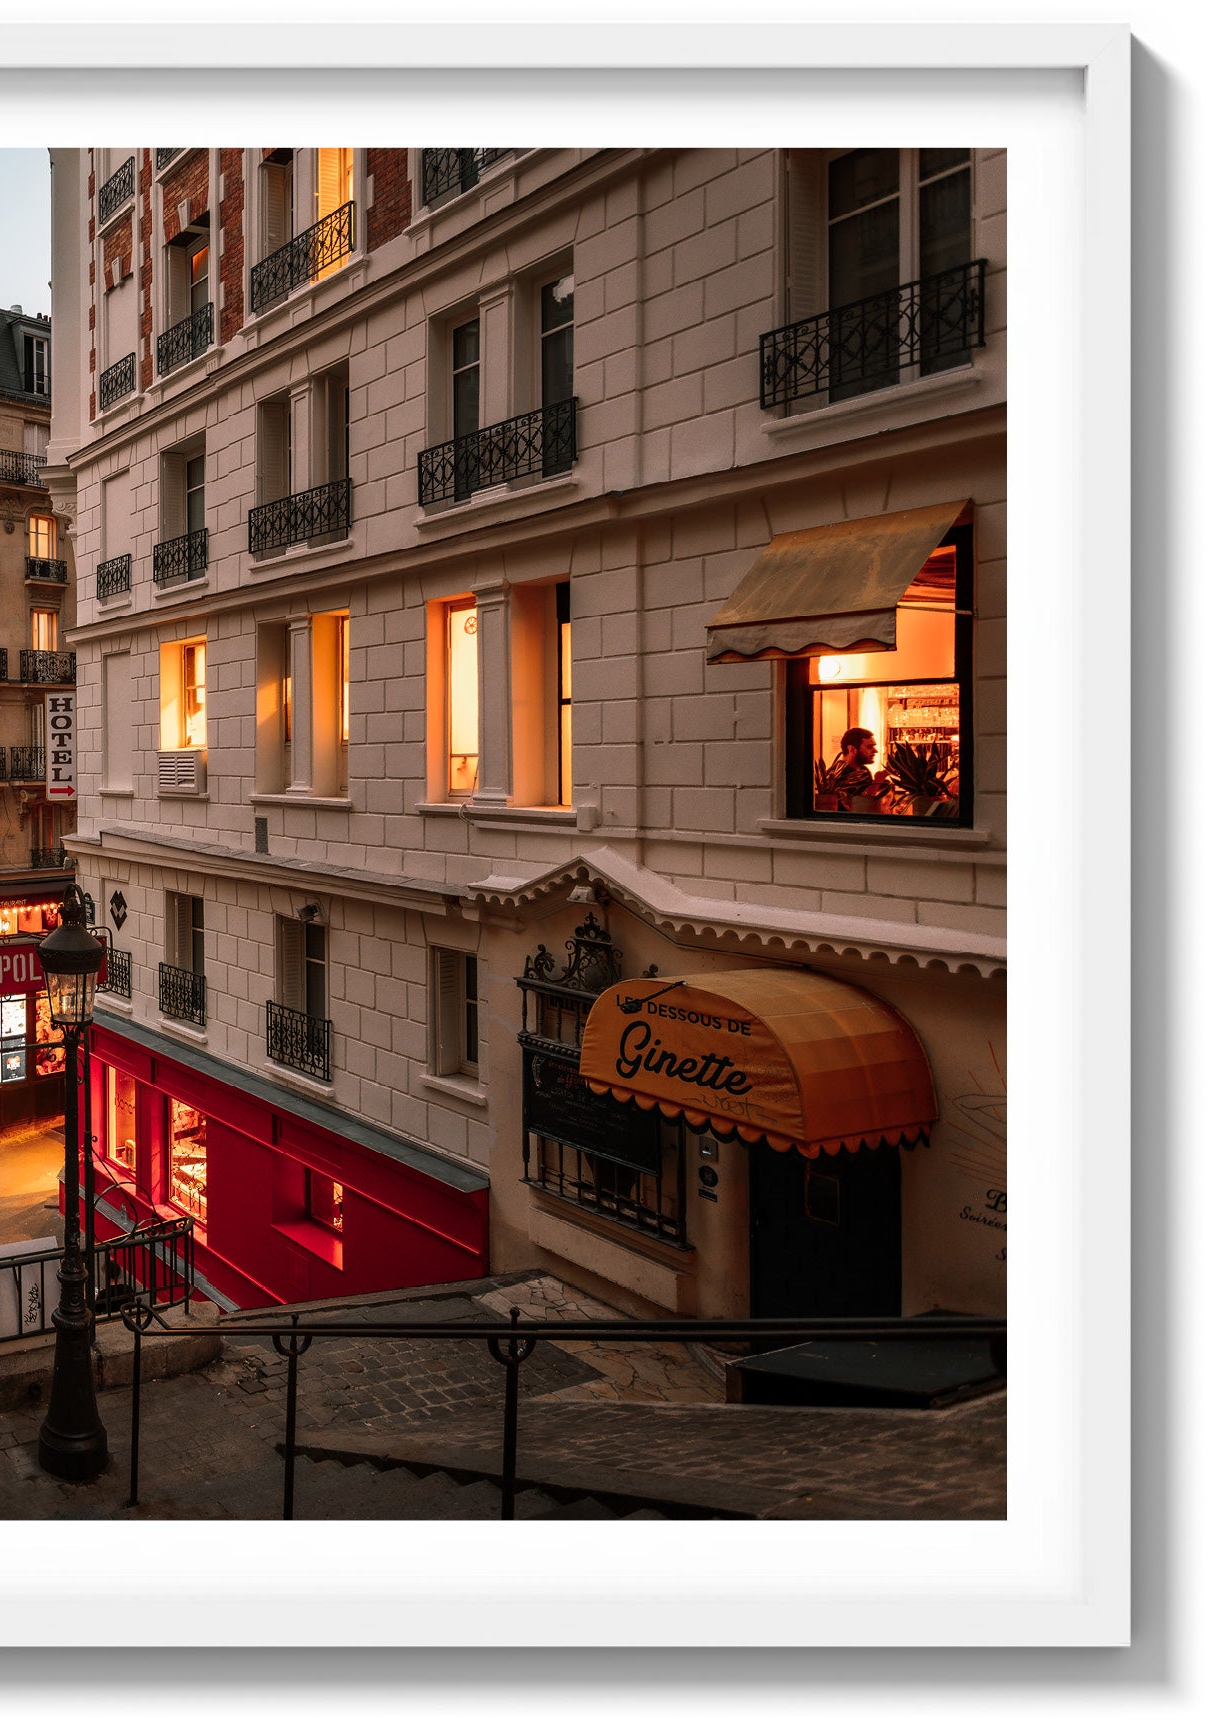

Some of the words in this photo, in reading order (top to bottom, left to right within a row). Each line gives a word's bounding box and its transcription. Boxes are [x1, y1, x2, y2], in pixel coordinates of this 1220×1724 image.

[49, 697, 73, 782] HOTEL
[647, 1000, 721, 1030] DESSOUS
[727, 1018, 752, 1036] DE
[616, 1020, 753, 1096] Ginette
